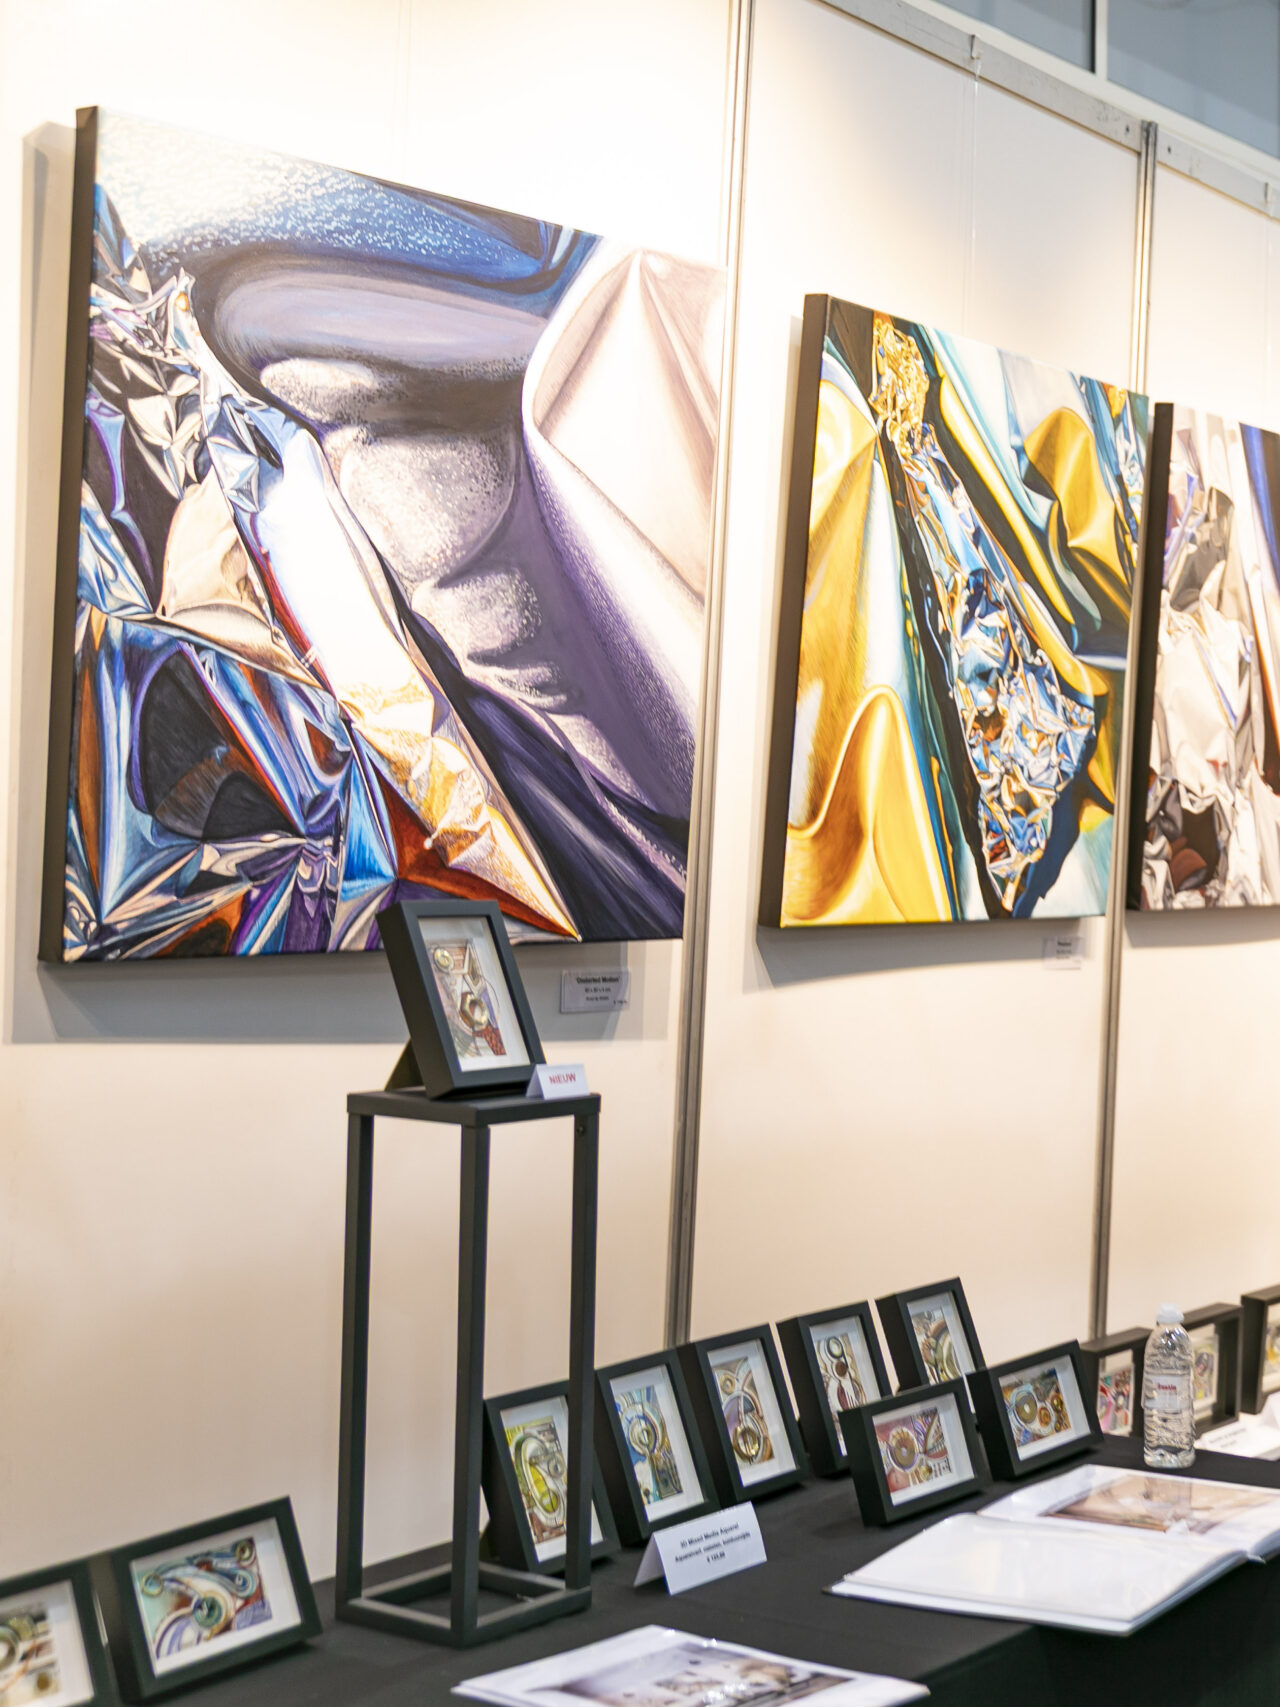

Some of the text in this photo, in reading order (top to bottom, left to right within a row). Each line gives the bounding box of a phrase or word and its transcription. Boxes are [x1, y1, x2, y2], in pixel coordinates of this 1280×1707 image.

[549, 1072, 576, 1085] NIEUW
[688, 1535, 704, 1545] Mixed
[703, 1529, 720, 1540] Media
